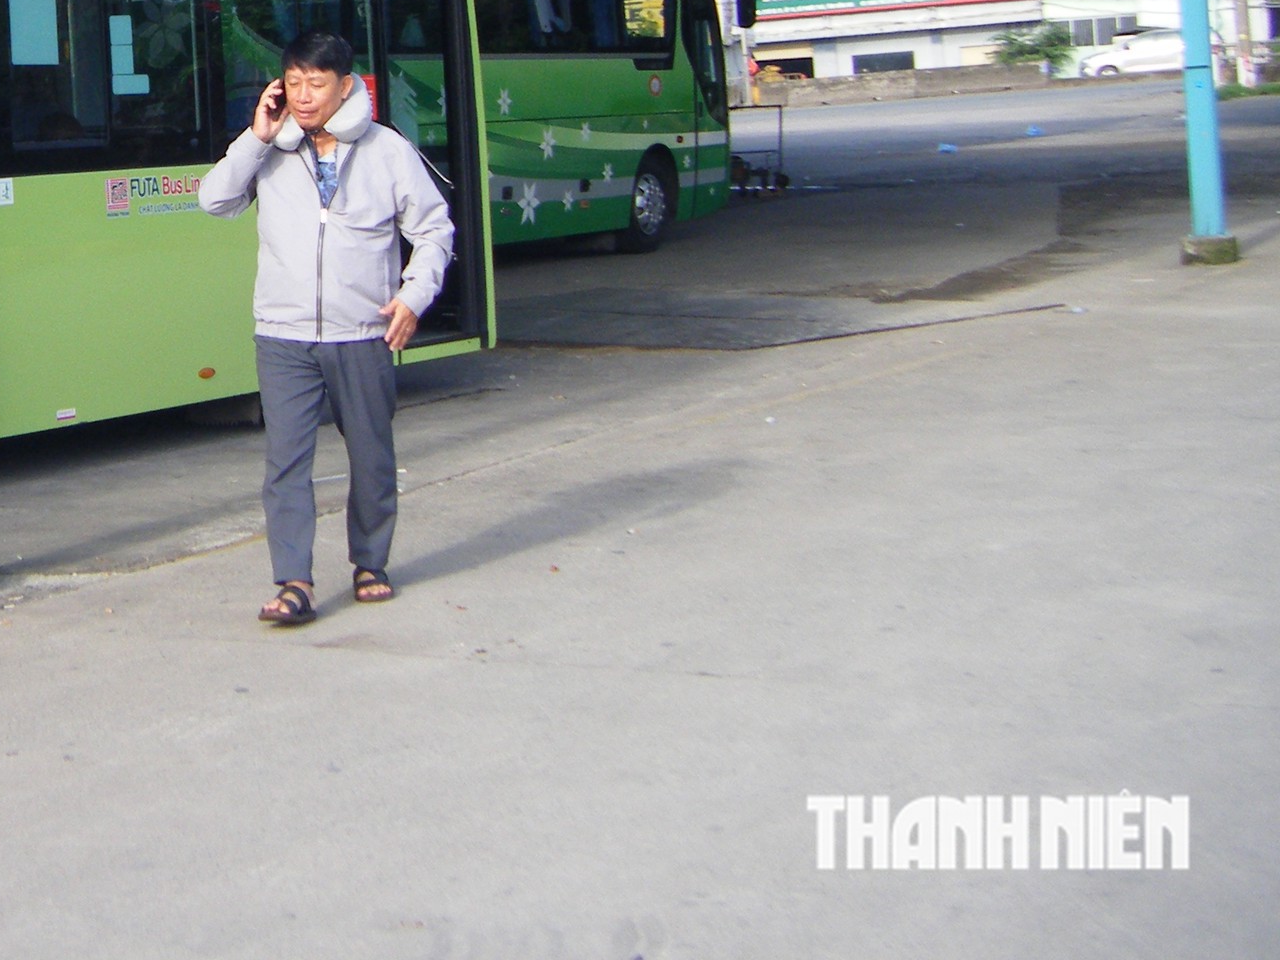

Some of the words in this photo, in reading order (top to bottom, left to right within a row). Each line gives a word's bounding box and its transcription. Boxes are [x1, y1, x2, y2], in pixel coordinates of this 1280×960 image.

[130, 177, 159, 197] FUTA
[162, 176, 182, 194] Bus
[184, 174, 200, 193] Lin
